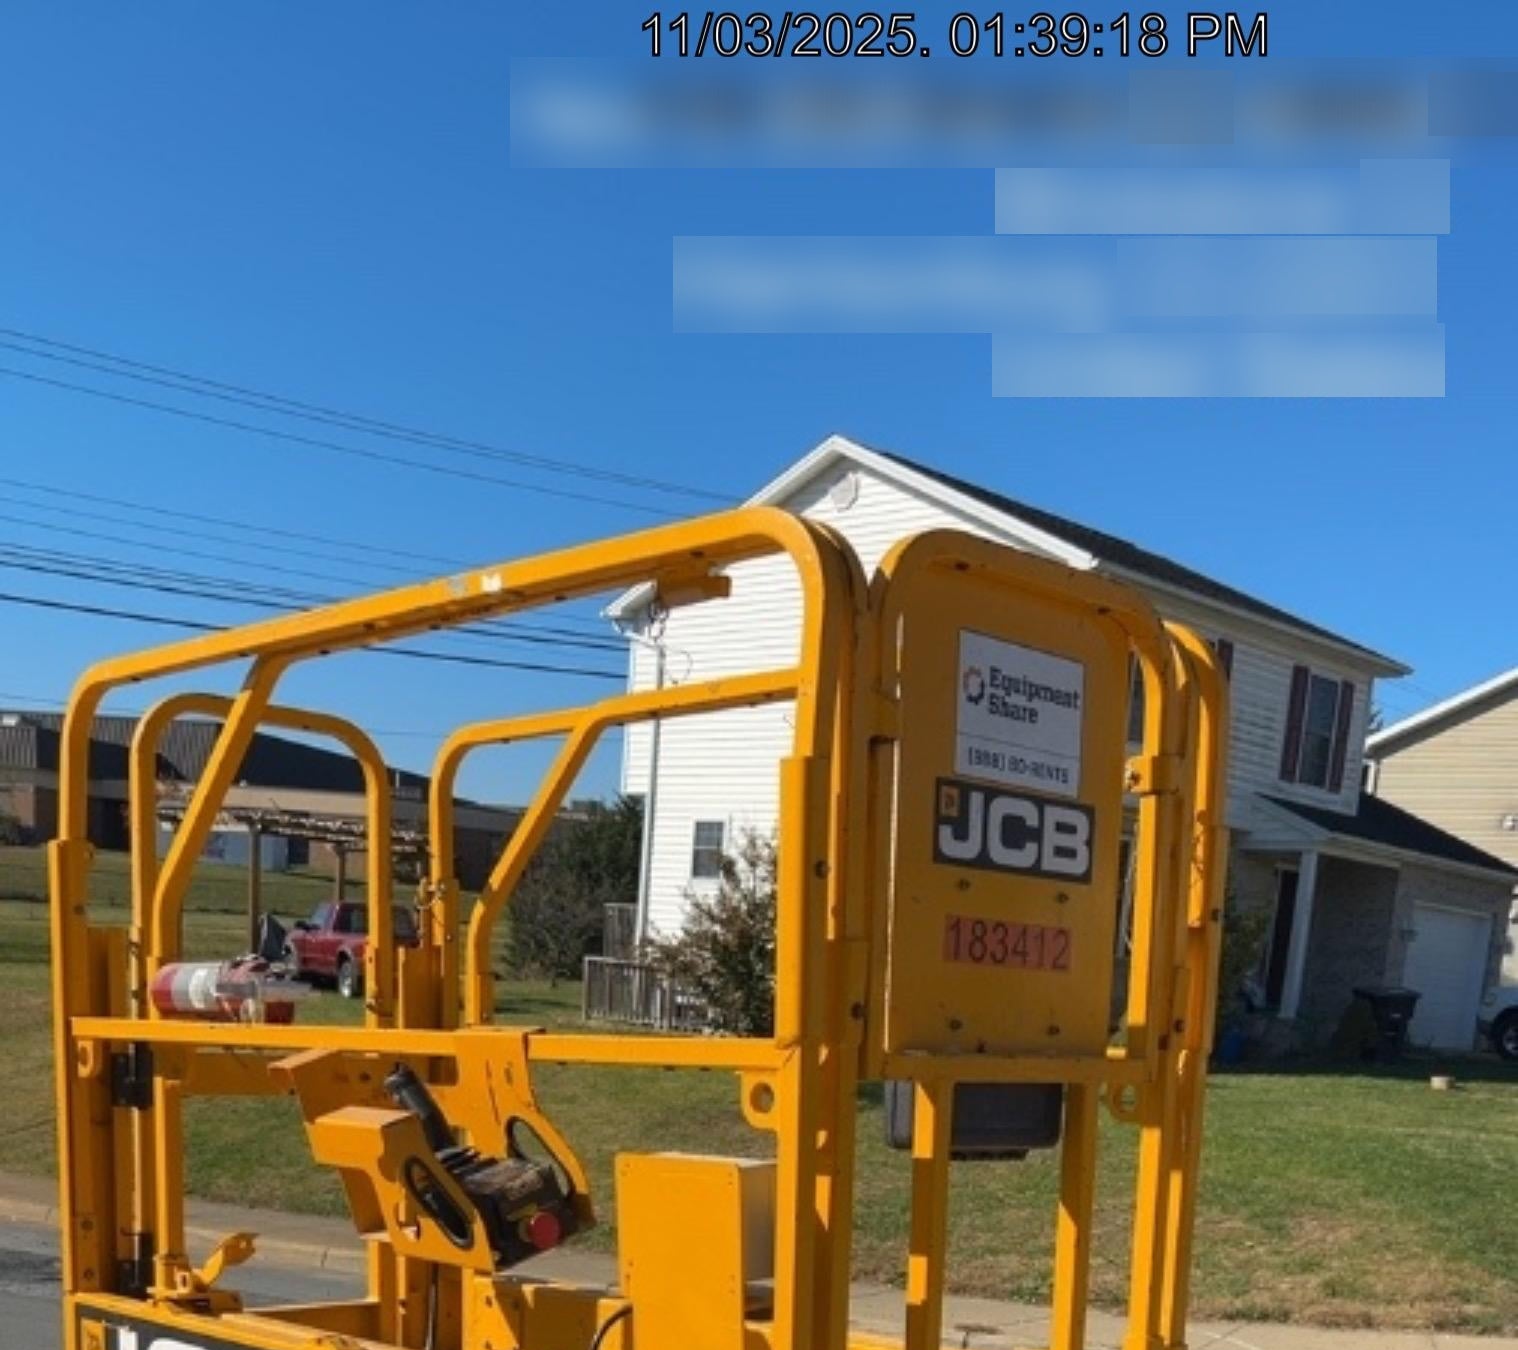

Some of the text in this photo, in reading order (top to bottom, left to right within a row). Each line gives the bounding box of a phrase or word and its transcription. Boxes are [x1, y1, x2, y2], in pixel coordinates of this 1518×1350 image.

[988, 692, 1039, 724] Share
[989, 665, 1080, 710] Equipment
[938, 791, 1090, 876] JCB
[949, 917, 1070, 971] 183412
